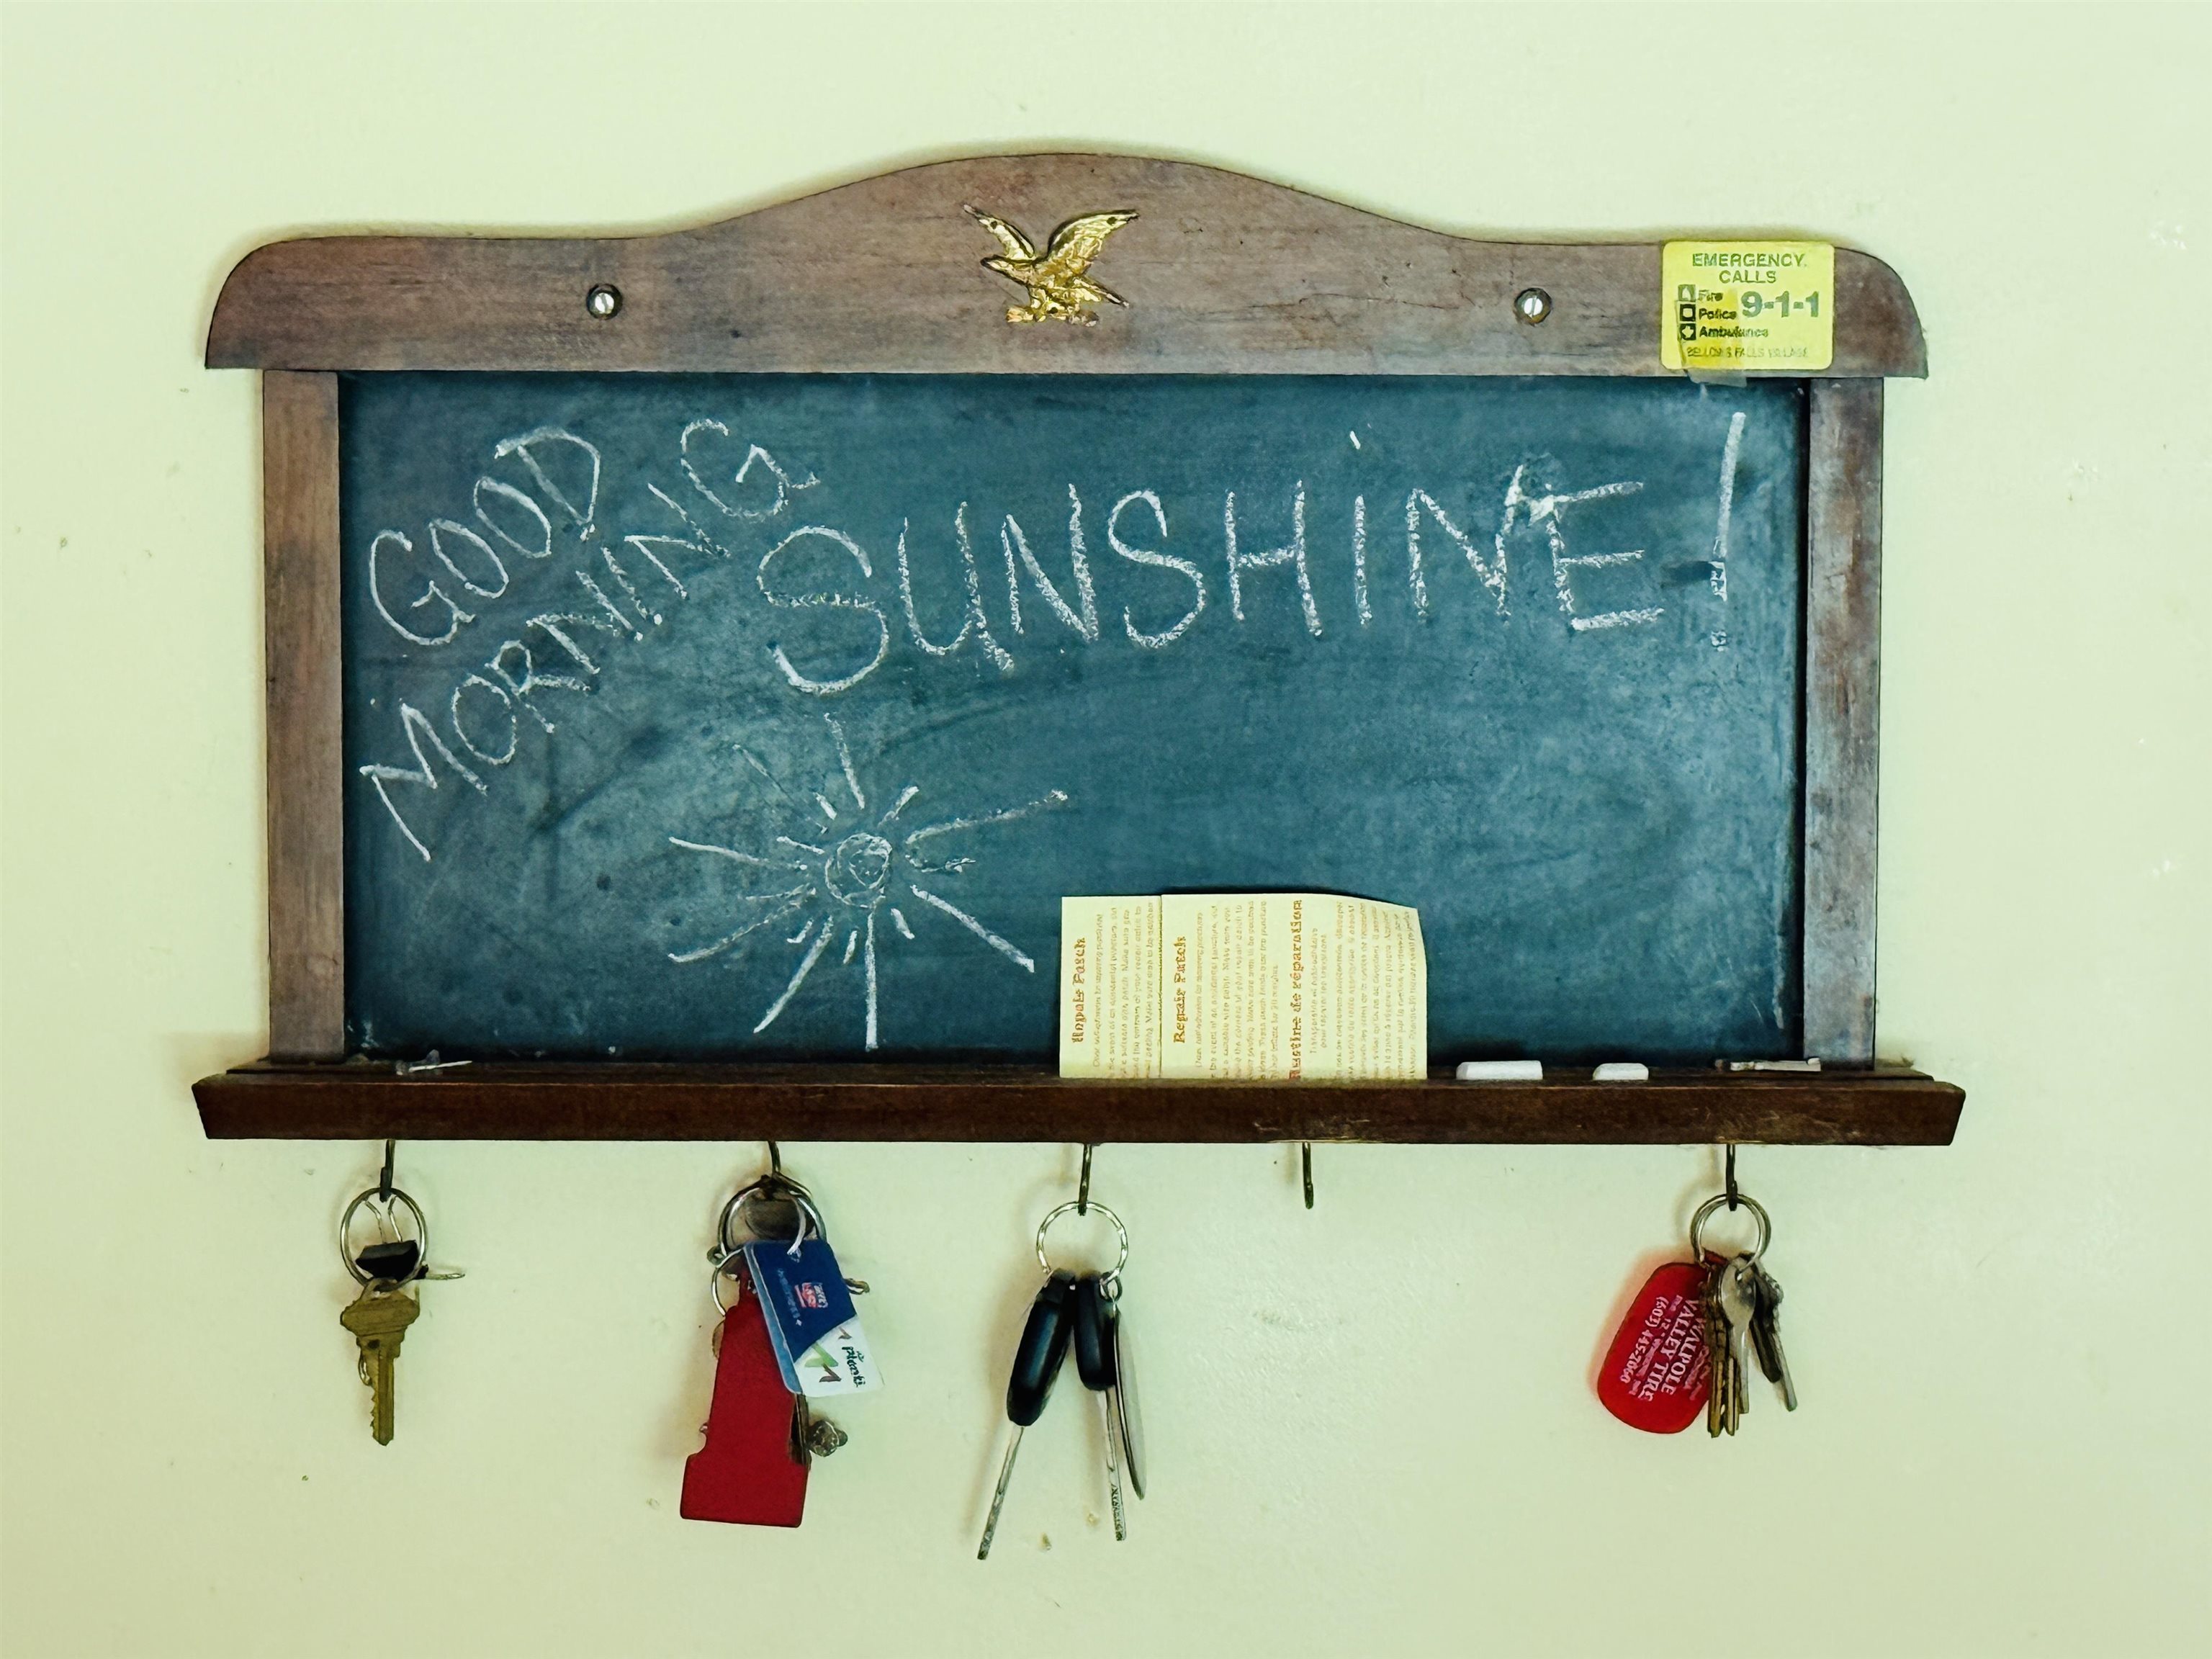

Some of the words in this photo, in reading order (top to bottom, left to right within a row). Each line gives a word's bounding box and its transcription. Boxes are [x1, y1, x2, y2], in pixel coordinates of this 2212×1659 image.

[1692, 253, 1806, 267] EMERGENCY
[1719, 269, 1777, 284] CALLS
[1698, 307, 1737, 320] Police
[1741, 290, 1820, 318] 9-1-1
[1699, 325, 1769, 338] Ambulance
[369, 426, 601, 646] GOOD
[359, 419, 820, 862] MORNING
[1659, 1298, 1699, 1360] VALLEY
[1660, 1317, 1706, 1395] WALPOLE
